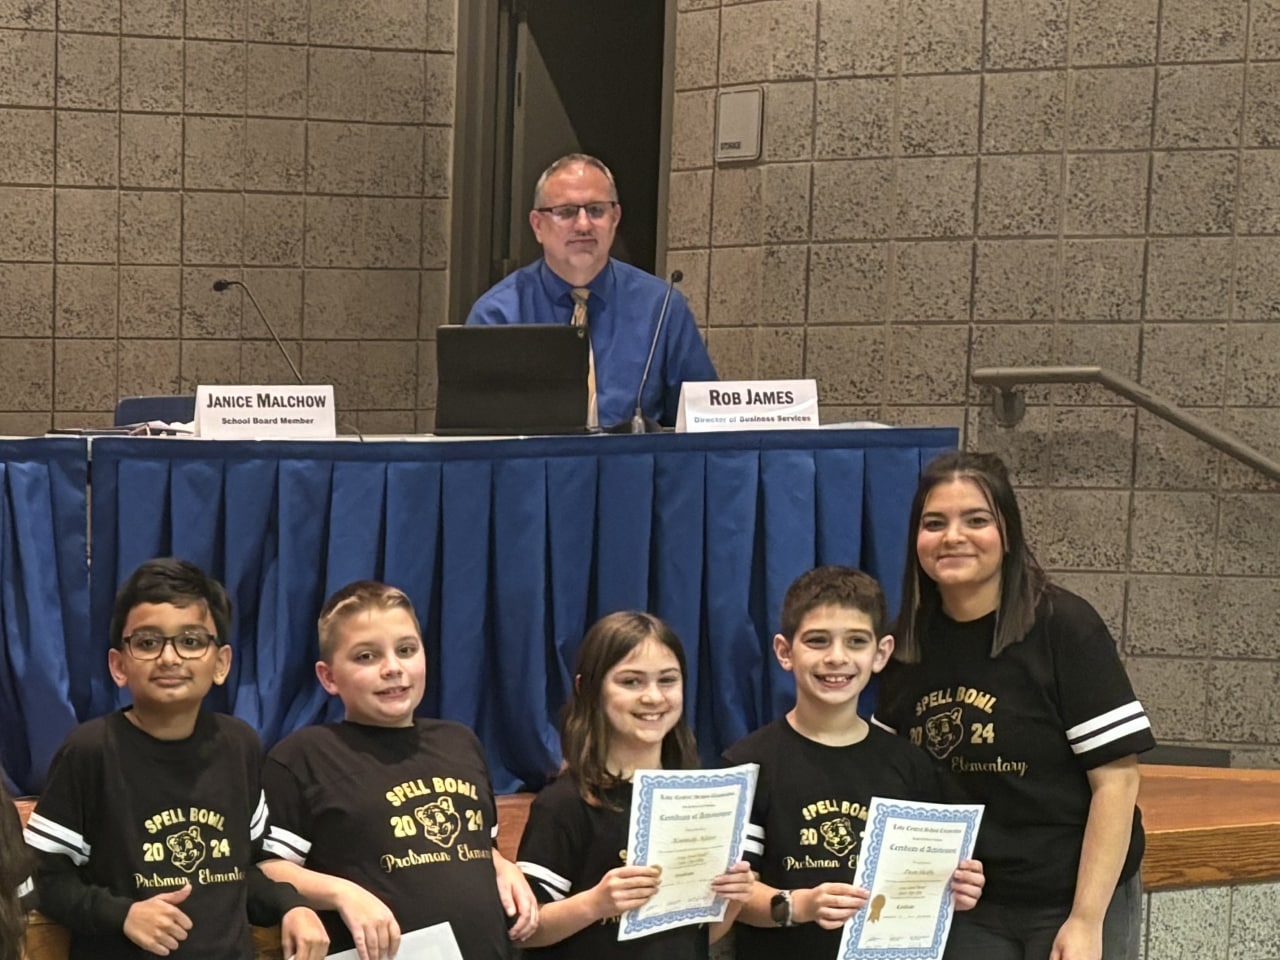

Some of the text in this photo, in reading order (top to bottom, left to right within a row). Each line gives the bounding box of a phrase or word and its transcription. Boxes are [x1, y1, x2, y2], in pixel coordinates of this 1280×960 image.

[207, 393, 326, 408] JANICE MALCHOW
[709, 388, 794, 406] ROB JAMES
[221, 417, 251, 425] School
[252, 417, 278, 425] Board
[694, 416, 726, 424] Director
[739, 415, 775, 423] Business
[915, 686, 997, 716] SPELL BOWL
[970, 722, 995, 744] 24
[951, 755, 1028, 777] Elementary
[385, 777, 479, 807] SPELL BOWL
[144, 807, 225, 834] SPELL BOWL
[801, 799, 840, 821] SPELL
[390, 809, 484, 838] 20 24
[799, 827, 819, 846] 20
[142, 838, 231, 862] 20 24
